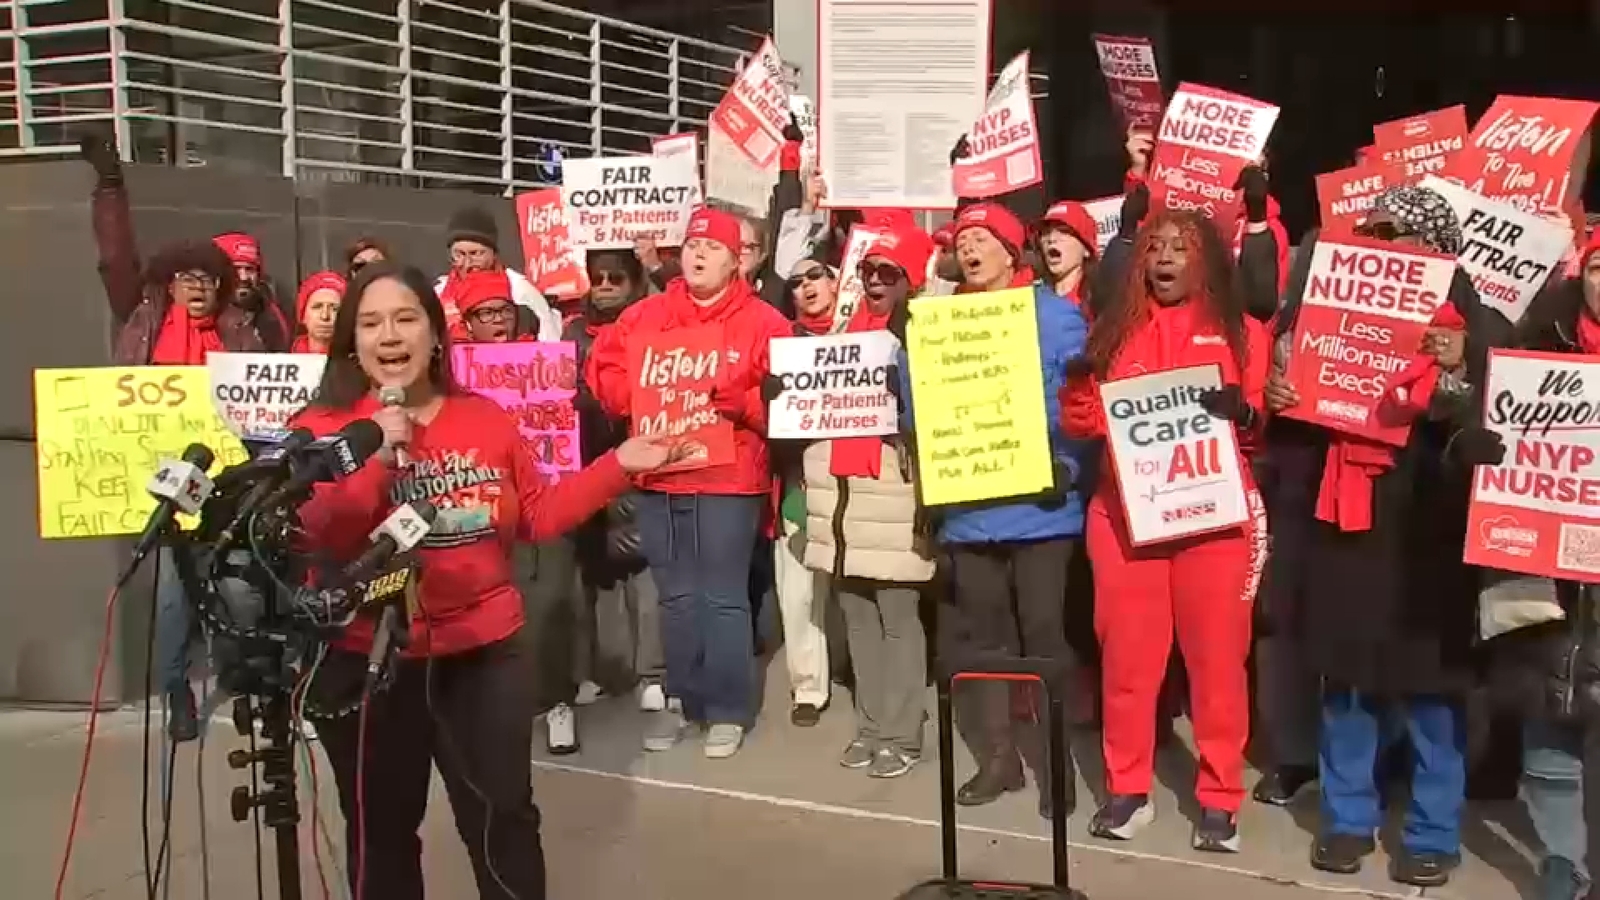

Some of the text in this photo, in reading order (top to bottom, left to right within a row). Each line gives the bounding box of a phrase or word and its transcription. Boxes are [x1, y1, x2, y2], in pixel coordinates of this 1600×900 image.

[1103, 46, 1142, 62] MORE
[738, 80, 786, 131] NURSE
[1181, 98, 1255, 129] MORE
[973, 108, 1011, 137] NYP
[1162, 118, 1257, 154] NURSES
[967, 121, 1031, 158] URSES
[602, 166, 651, 185] FAIR
[1181, 148, 1219, 176] Less
[570, 186, 689, 208] CONTRACT
[1153, 162, 1236, 204] Millionaire
[1342, 175, 1384, 197] SAFE
[579, 207, 680, 225] For Patients
[1331, 192, 1377, 216] NURS
[594, 227, 606, 242] &
[1463, 208, 1525, 248] FAIR
[1330, 249, 1427, 286] MORE
[1309, 274, 1439, 316] NURSES
[1339, 311, 1394, 344] Less
[814, 344, 861, 367] FAIR
[246, 363, 300, 382] FAIR
[1318, 361, 1386, 399] Exec$
[1538, 369, 1584, 397] We
[116, 374, 187, 408] SOS
[787, 395, 817, 411] For
[226, 404, 250, 422] For
[800, 412, 879, 430] & Nurses
[1128, 412, 1211, 447] Care
[1133, 437, 1222, 484] for All
[1515, 438, 1595, 474] NYP
[389, 466, 502, 506] UNSTOPPABLE
[1482, 466, 1600, 506] NURSE
